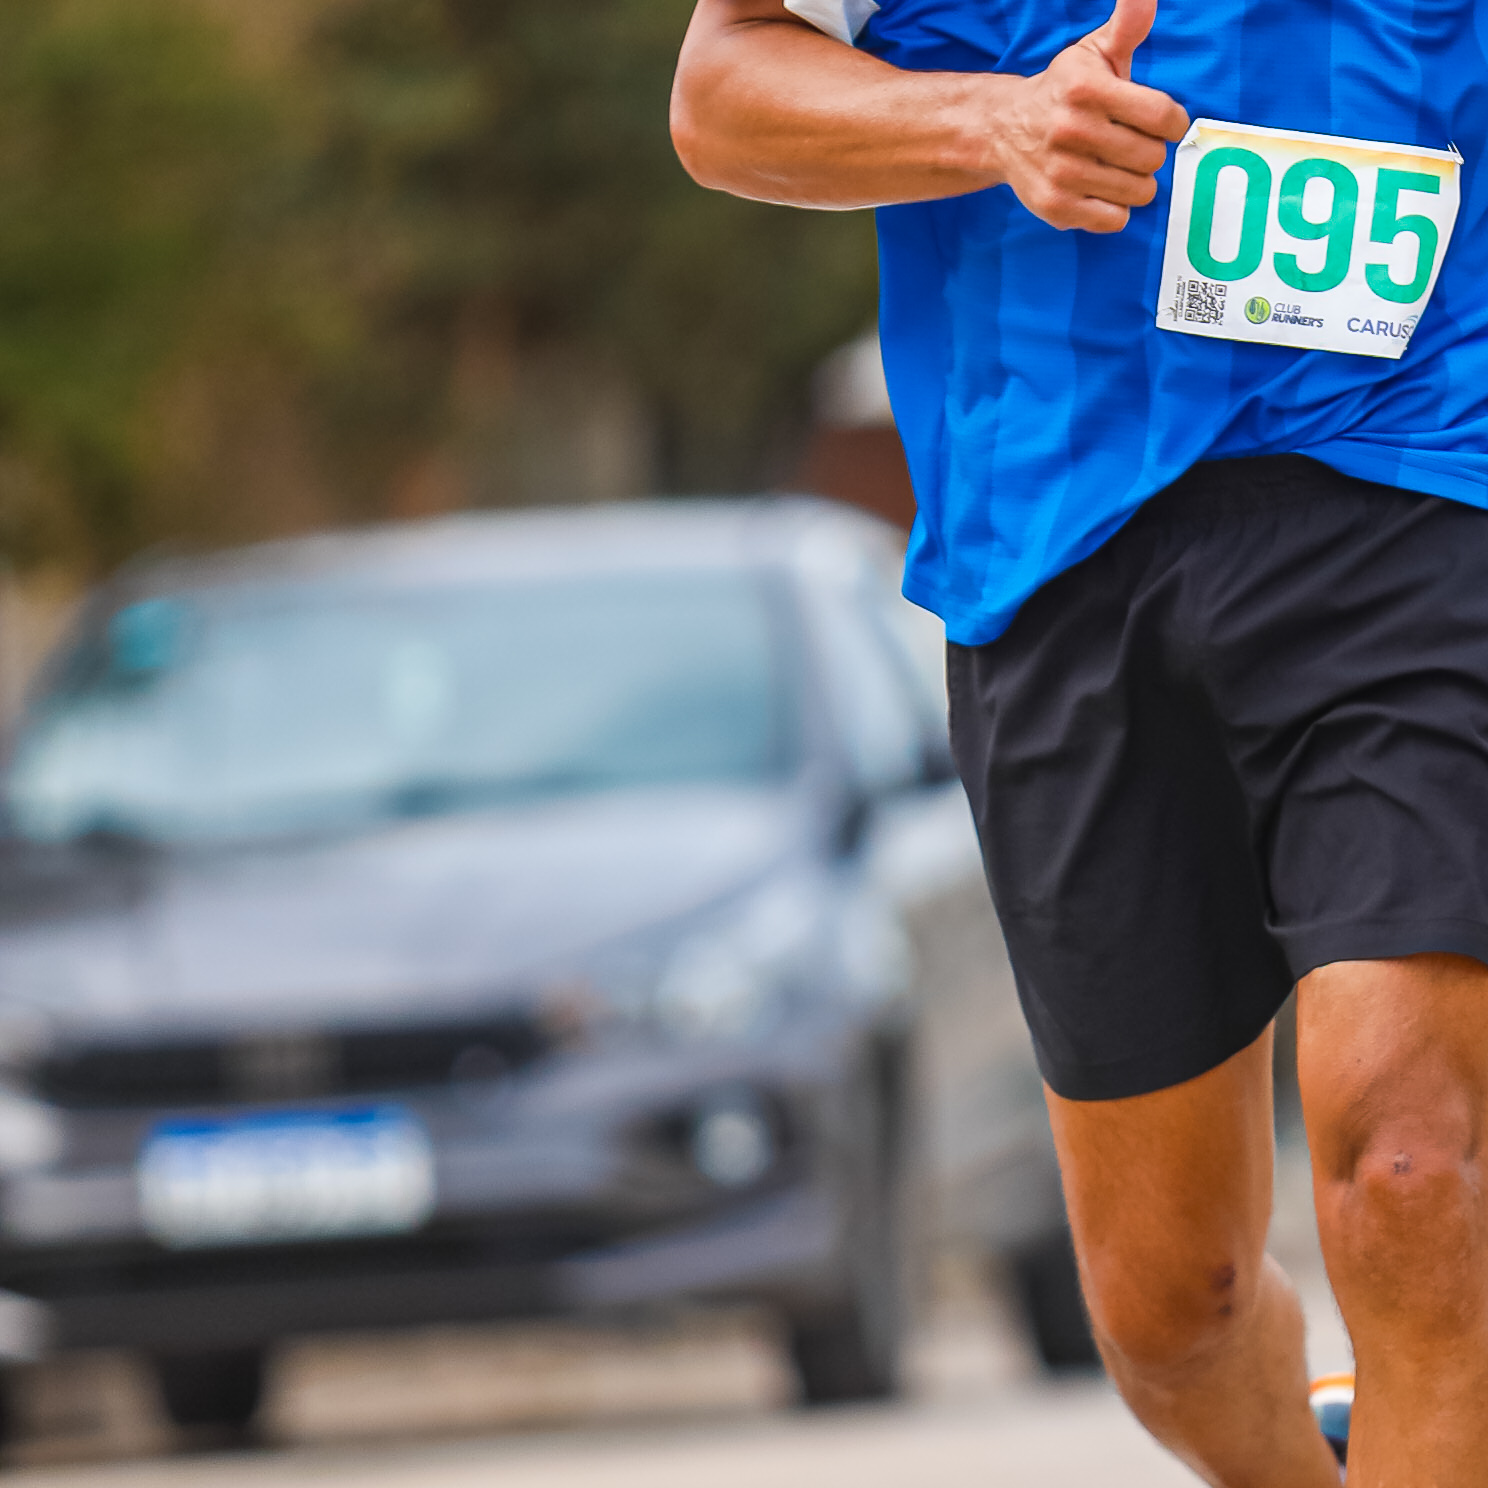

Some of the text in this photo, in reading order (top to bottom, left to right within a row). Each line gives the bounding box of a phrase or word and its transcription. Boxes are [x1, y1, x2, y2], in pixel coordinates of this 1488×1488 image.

[1186, 146, 1441, 304] 095
[1274, 302, 1302, 315] CLUB
[1271, 312, 1325, 328] RUNNER'S
[1346, 317, 1413, 341] CARUS
